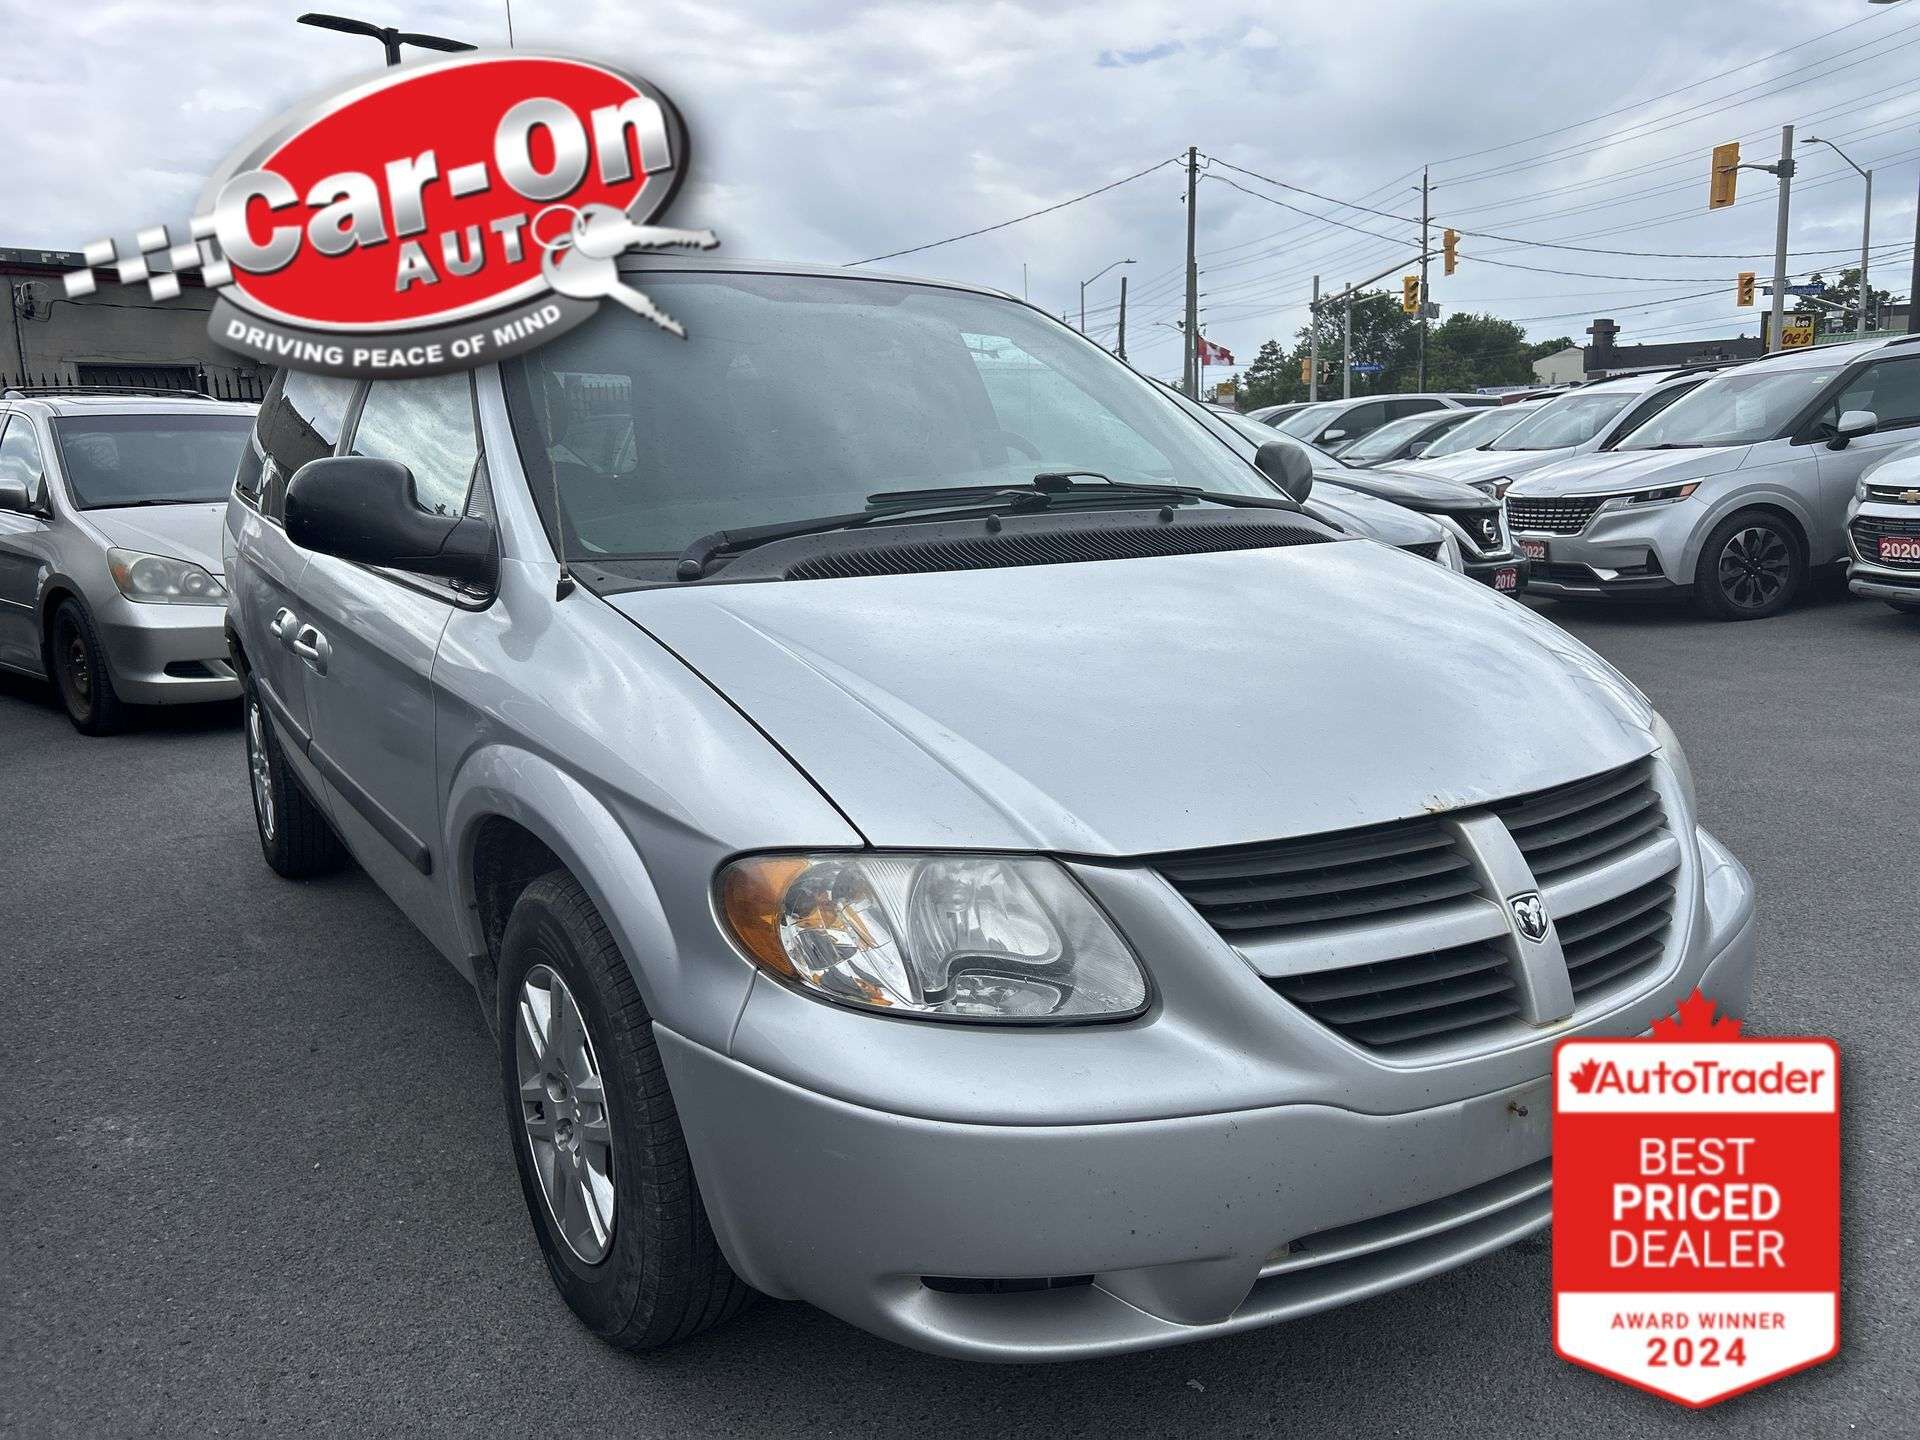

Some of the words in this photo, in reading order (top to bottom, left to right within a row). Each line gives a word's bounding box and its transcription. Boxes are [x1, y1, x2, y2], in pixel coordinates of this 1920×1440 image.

[1782, 329, 1812, 345] oe's
[1881, 542, 1920, 559] 2020
[1495, 573, 1516, 589] 2016
